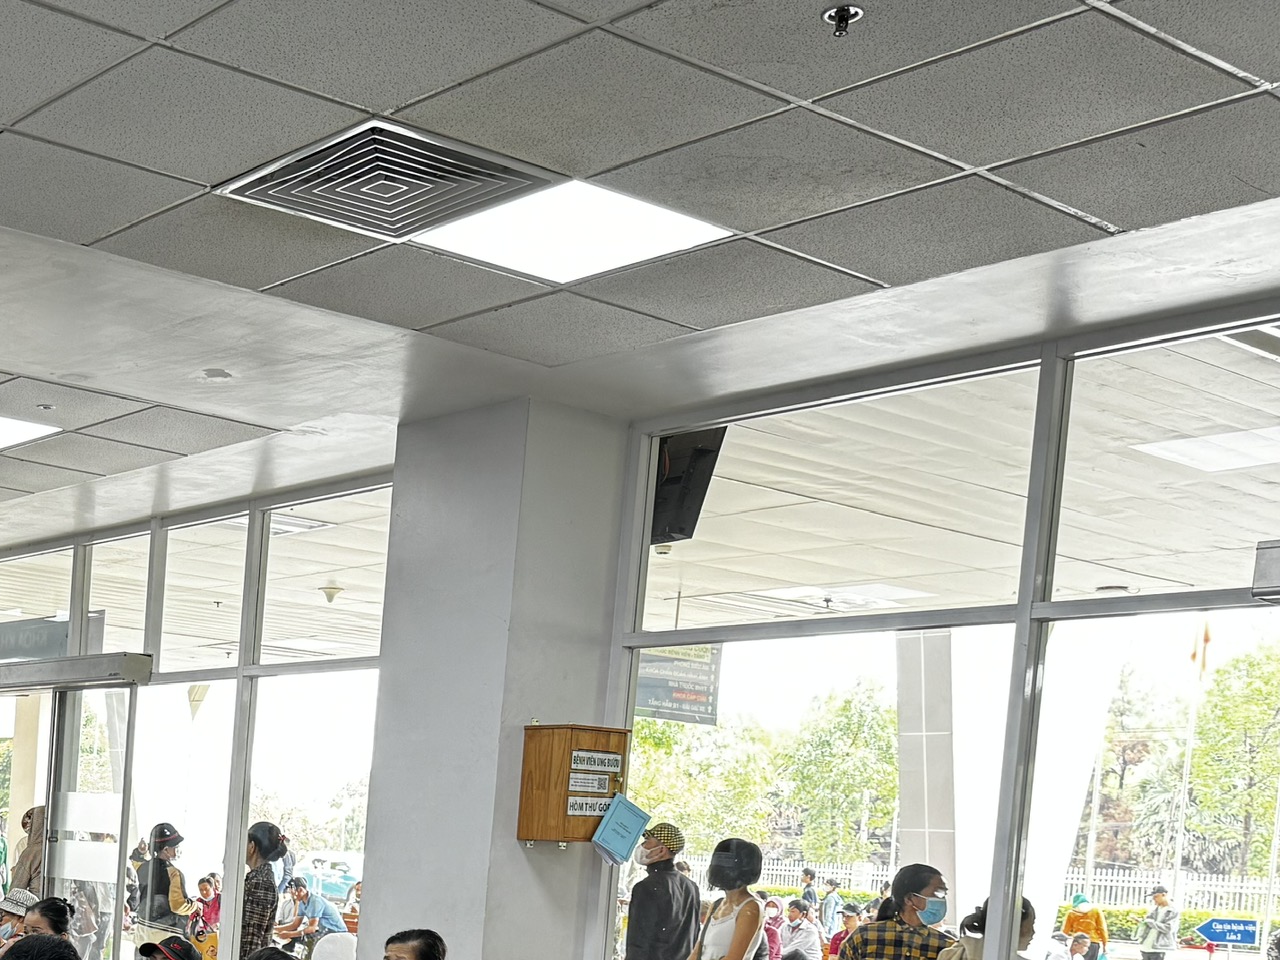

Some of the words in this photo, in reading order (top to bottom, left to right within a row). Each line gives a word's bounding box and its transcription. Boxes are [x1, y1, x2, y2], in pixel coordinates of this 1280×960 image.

[573, 754, 585, 767] BỆNH
[597, 757, 607, 767] UNG
[569, 800, 584, 811] HÒM
[584, 802, 597, 812] THƯ
